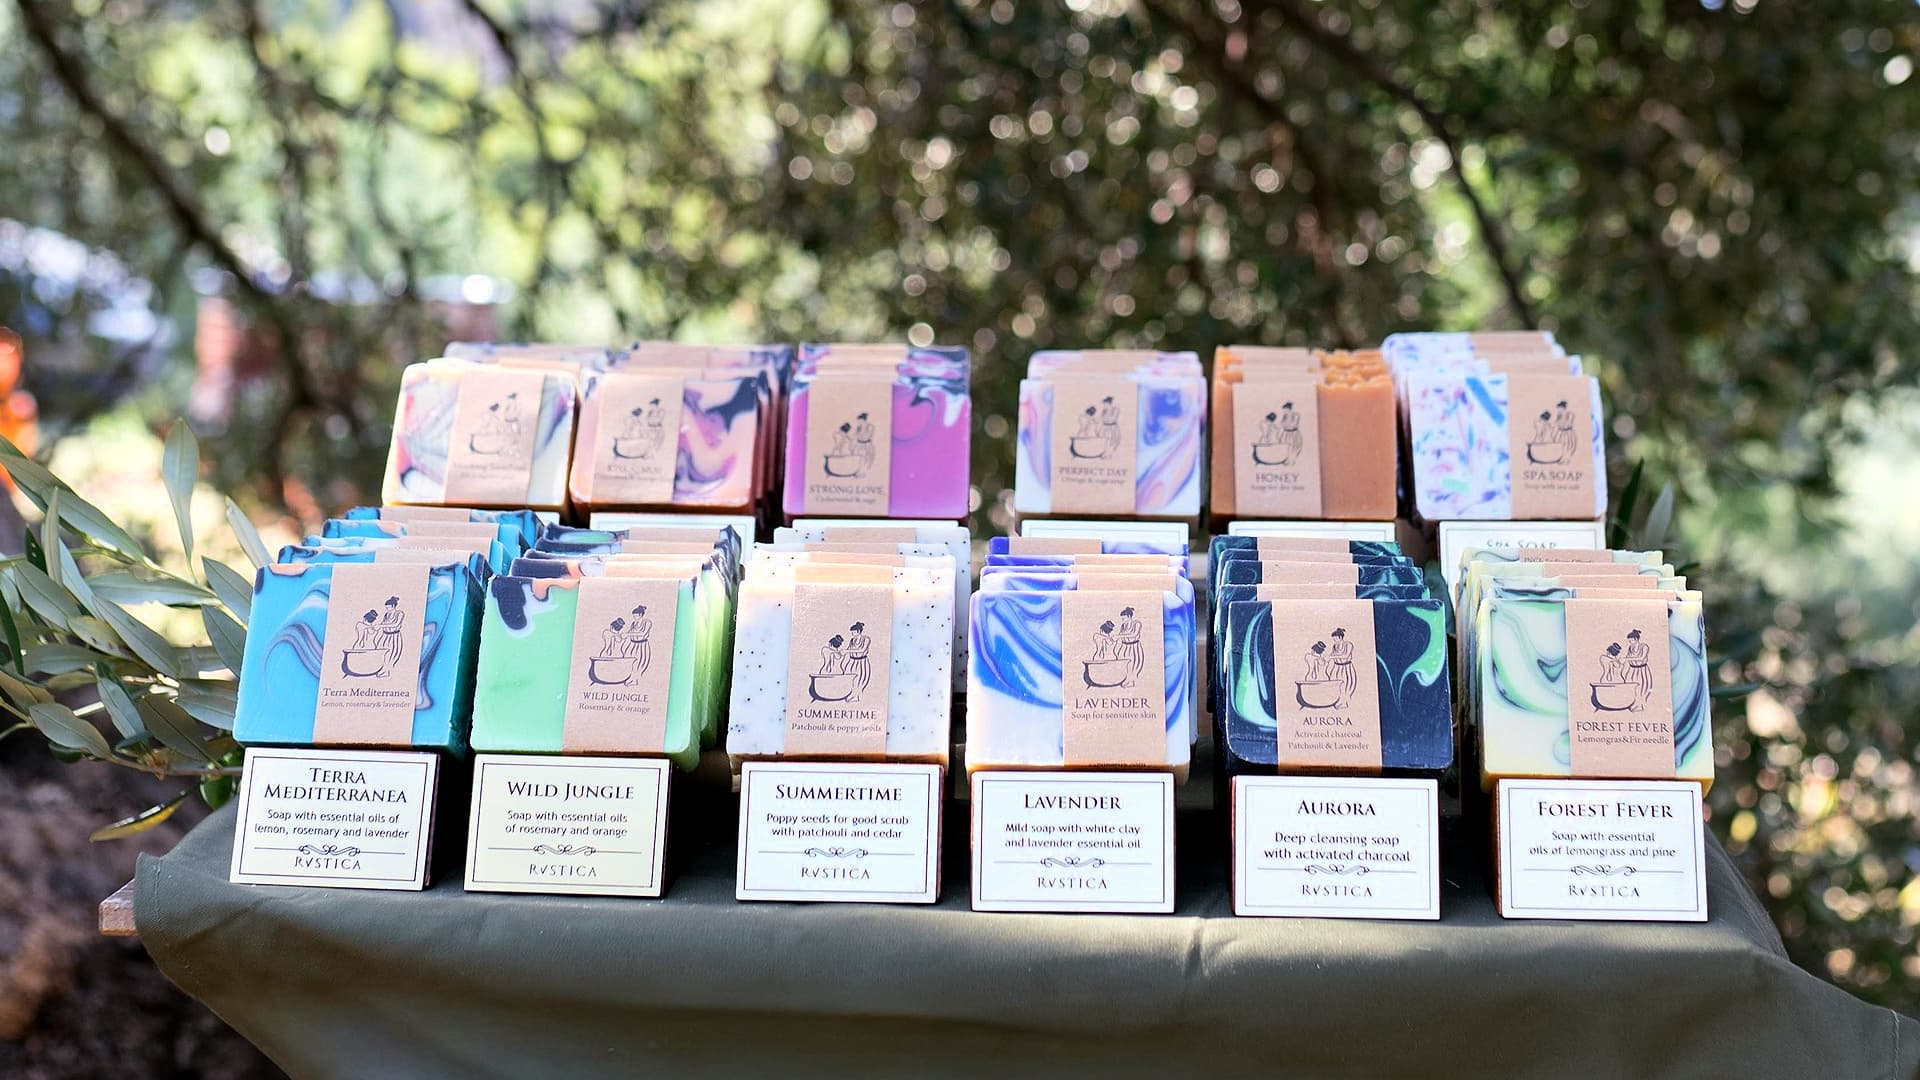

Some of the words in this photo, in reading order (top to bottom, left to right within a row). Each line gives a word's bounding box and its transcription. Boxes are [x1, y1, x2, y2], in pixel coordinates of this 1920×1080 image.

[1059, 467, 1105, 475] PERFECT
[1107, 468, 1128, 476] DAY
[1523, 471, 1546, 480] SPA
[1549, 471, 1582, 481] SOAP
[1256, 473, 1300, 483] HONEY
[809, 484, 853, 494] STRONG
[856, 486, 883, 494] LOVE
[323, 688, 348, 697] Terra
[350, 688, 410, 698] Mediterranea
[583, 692, 608, 700] WILD
[611, 693, 649, 703] JUNGLE
[579, 703, 615, 712] Rosemary
[1075, 698, 1151, 709] LAVENDER
[797, 709, 877, 720] SUMMERTIME
[1071, 711, 1090, 720] Soap
[1302, 716, 1353, 726] AURORA
[1576, 721, 1624, 732] FOREST
[1628, 722, 1669, 733] FEVER
[836, 725, 859, 733] poppy
[1642, 735, 1669, 744] needle
[309, 767, 366, 784] TERRA
[264, 784, 407, 803] MEDITERRANEA
[507, 781, 558, 798] WILD
[563, 783, 635, 801] JUNGLE
[775, 784, 902, 801] SUMMERTIME
[1024, 794, 1122, 810] LAVENDER
[1297, 800, 1376, 816] AURORA
[1538, 801, 1609, 817] FOREST
[1616, 802, 1673, 818] FEVER
[268, 809, 291, 821] Soap
[294, 810, 317, 821] with
[320, 811, 364, 822] essential
[368, 812, 386, 823] oils
[389, 813, 400, 823] of
[507, 810, 531, 821] Soap
[536, 810, 558, 821] with
[561, 811, 606, 822] essential
[610, 812, 628, 822] oils
[766, 813, 798, 825] Poppy
[801, 814, 830, 824] seeds
[834, 814, 848, 824] for
[852, 815, 877, 826] good
[880, 815, 909, 825] scrub
[254, 823, 289, 835] lemon,
[293, 826, 340, 838] rosemary
[342, 827, 361, 837] and
[364, 827, 409, 839] lavender
[505, 824, 516, 833] of
[519, 826, 566, 836] rosemary
[570, 826, 589, 836] and
[592, 828, 628, 838] orange
[772, 827, 795, 837] with
[798, 827, 847, 839] patchouli
[850, 828, 870, 838] and
[873, 828, 902, 838] cedar
[1005, 823, 1028, 833] Mild
[1031, 825, 1056, 835] soap
[1059, 824, 1082, 833] with
[1085, 824, 1115, 833] white
[1118, 824, 1141, 835] clay
[1274, 832, 1306, 845] Deep
[1310, 833, 1367, 846] cleansing
[1371, 836, 1400, 846] soap
[1552, 831, 1577, 843] Soap
[1580, 831, 1604, 841] with
[1608, 832, 1656, 842] essential
[1005, 838, 1024, 847] and
[1028, 838, 1073, 848] lavender
[1077, 839, 1124, 849] essential
[1127, 840, 1141, 849] oil
[1264, 848, 1292, 859] with
[1296, 849, 1354, 861] activated
[1358, 850, 1411, 862] charcoal
[1530, 846, 1548, 855] oils
[1552, 846, 1562, 855] of
[1566, 846, 1626, 858] lemongrass
[1629, 847, 1648, 857] and
[1652, 847, 1676, 858] pine
